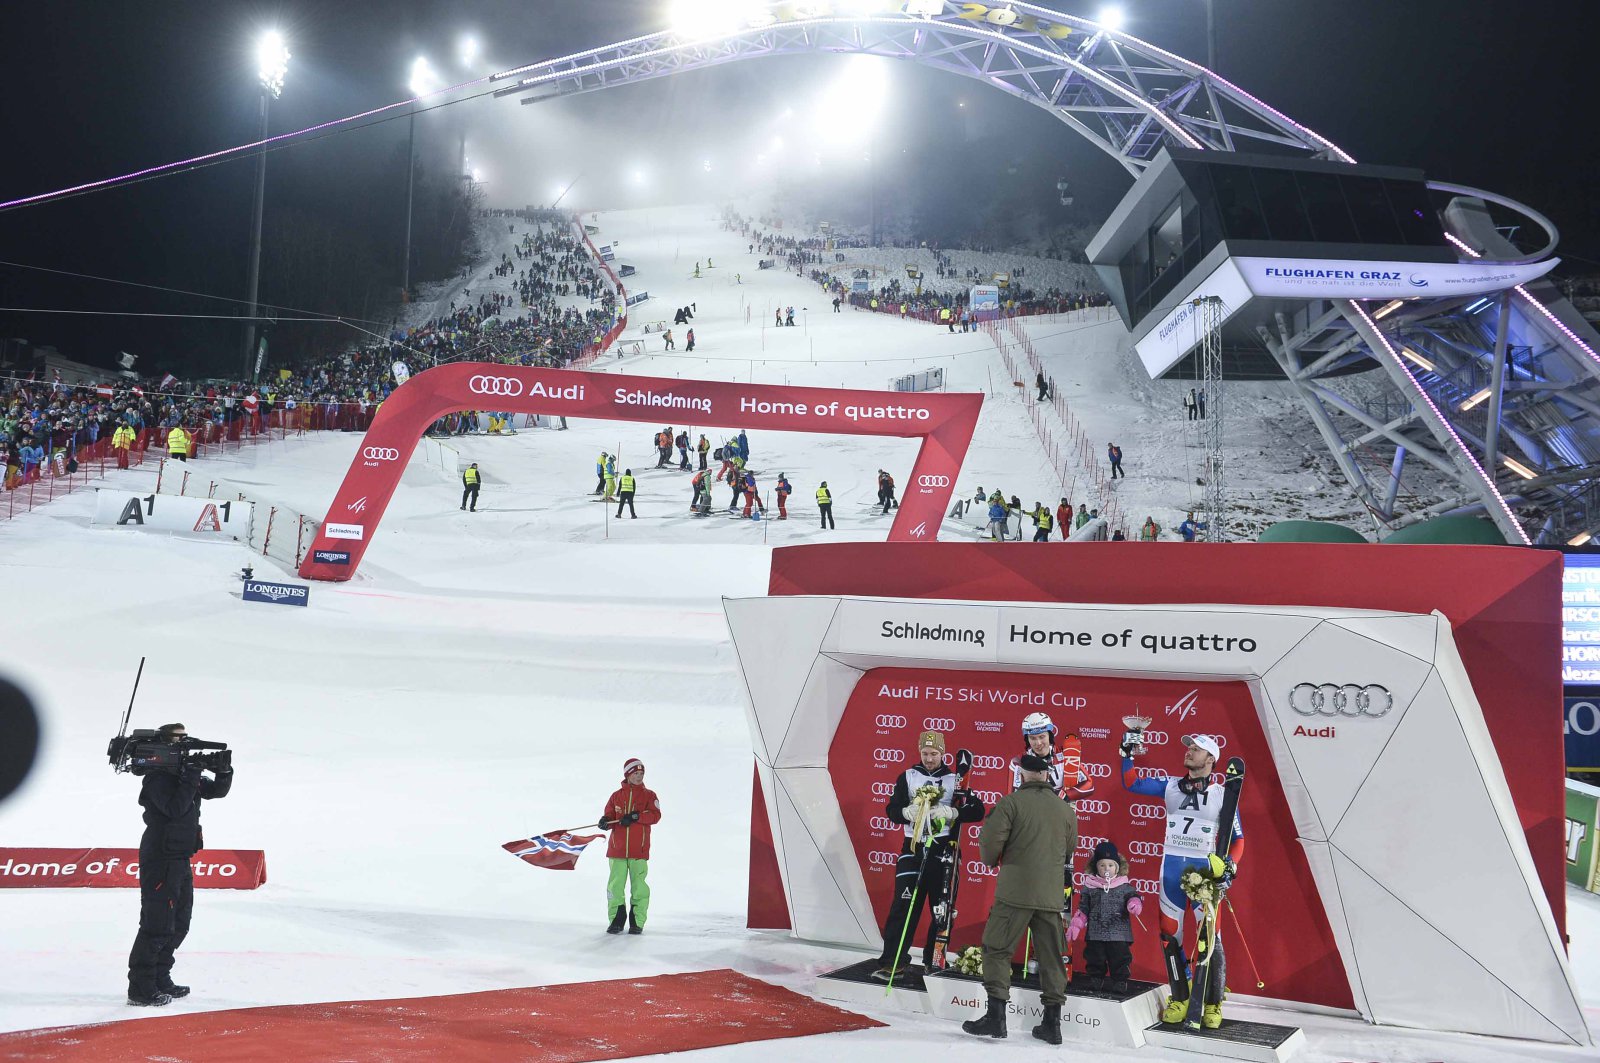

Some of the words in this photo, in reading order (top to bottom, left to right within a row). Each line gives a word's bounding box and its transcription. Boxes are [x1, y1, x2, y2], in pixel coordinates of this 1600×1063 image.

[1265, 268, 1355, 279] FLUGHAFEN
[1360, 270, 1401, 281] GRAZ
[1159, 308, 1188, 341] FLUGHAFEN
[529, 381, 584, 401] Audi
[614, 388, 712, 414] Schladming
[740, 397, 808, 416] Home
[814, 401, 839, 417] of
[844, 405, 930, 421] quattro
[116, 494, 156, 526] A1
[193, 501, 231, 532] A1
[948, 498, 971, 520] A1
[328, 527, 360, 536] Schladming
[316, 552, 347, 560] LONGINES
[246, 583, 307, 597] LONGINES
[881, 620, 985, 647] Schladming
[1009, 624, 1092, 647] Home
[1101, 629, 1133, 647] of
[1140, 633, 1257, 653] quattro
[878, 684, 919, 699] Audi
[925, 687, 953, 701] FIS
[958, 688, 984, 702] Ski
[988, 690, 1044, 705] World
[1051, 693, 1087, 710] Cup
[1293, 725, 1335, 738] Audi
[1179, 791, 1209, 811] A1
[1182, 817, 1194, 835] 7
[1171, 834, 1203, 843] SCHLADMING
[0, 858, 77, 876] Home
[85, 858, 121, 875] of
[125, 861, 237, 879] qtro
[951, 995, 980, 1009] Audi
[1008, 1004, 1027, 1015] Ski
[1075, 1013, 1101, 1028] Cup
